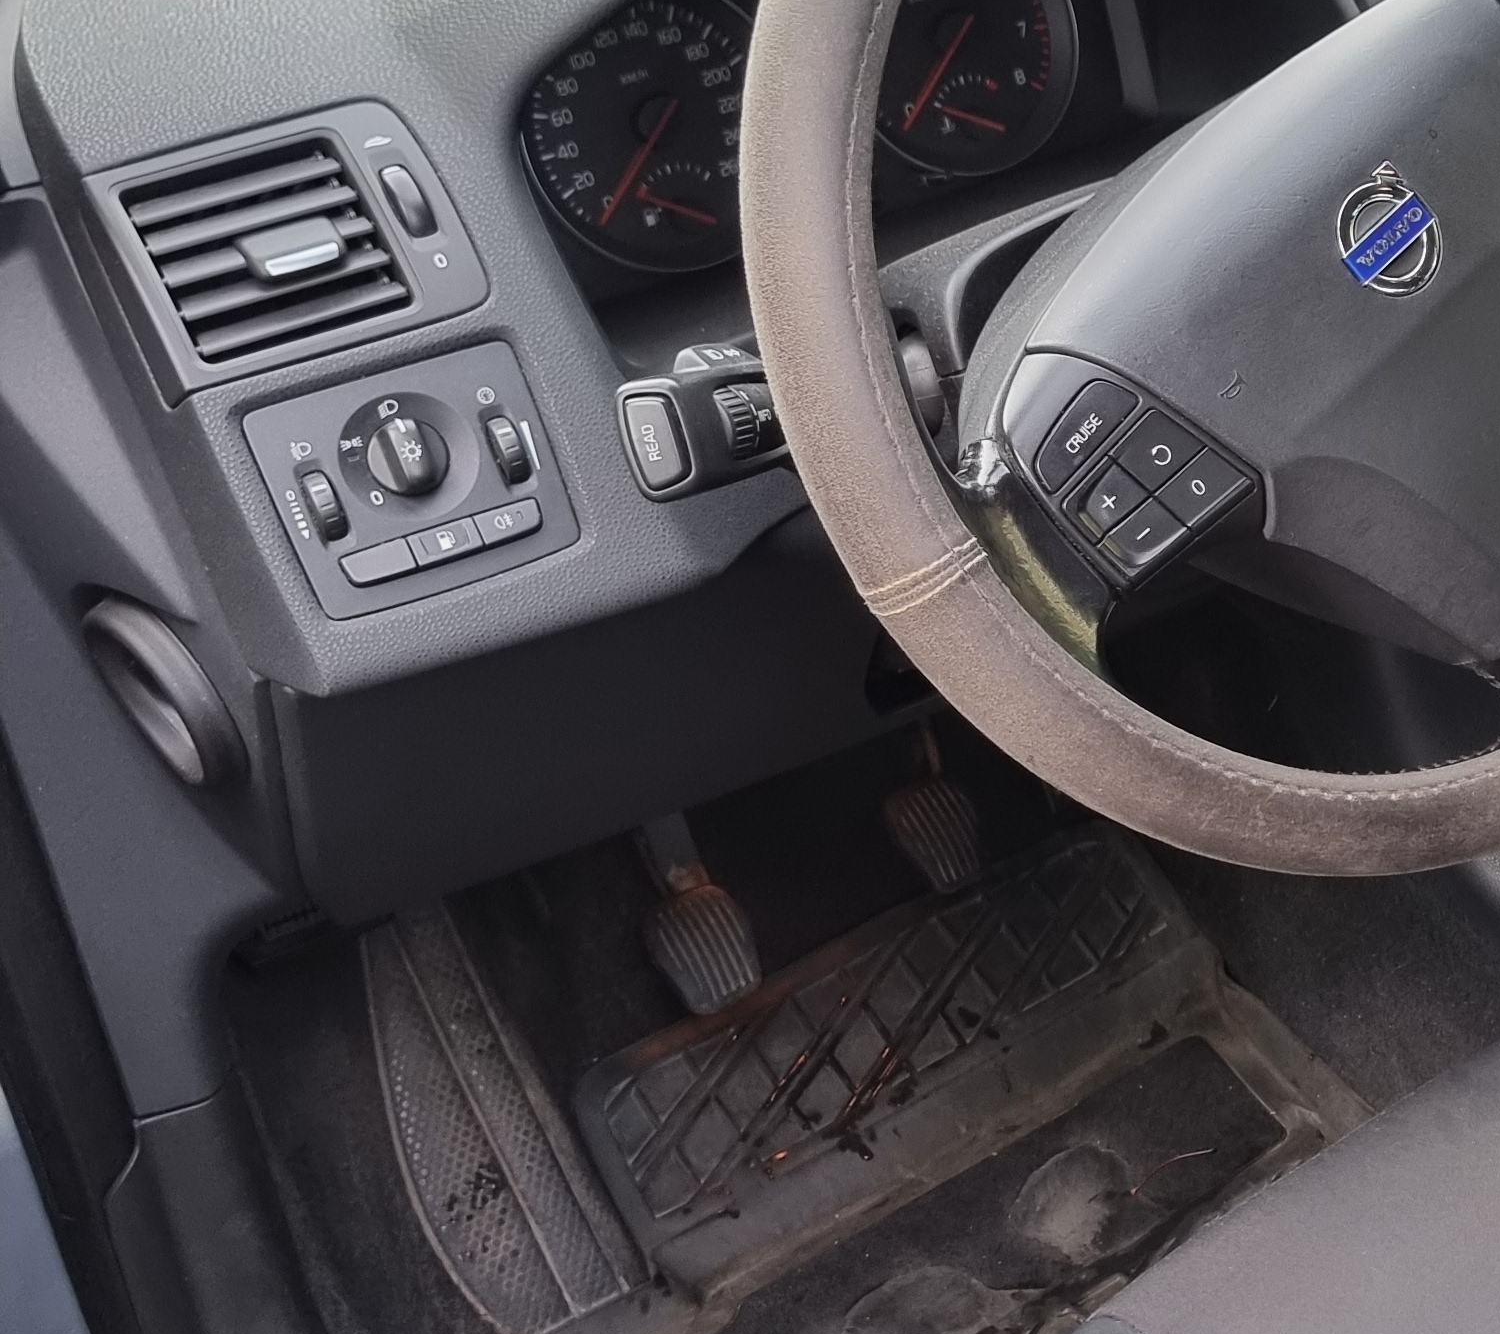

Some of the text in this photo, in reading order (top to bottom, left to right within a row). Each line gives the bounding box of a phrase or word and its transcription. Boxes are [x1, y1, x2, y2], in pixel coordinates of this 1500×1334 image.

[1015, 20, 1027, 38] 7
[569, 50, 596, 70] 100
[555, 77, 579, 96] 80
[701, 66, 731, 87] 200
[1013, 68, 1026, 85] 8
[718, 94, 740, 114] 22
[551, 108, 574, 127] 60
[557, 140, 579, 159] 40
[572, 169, 595, 191] 20
[1356, 207, 1423, 267] VOLVO
[641, 424, 663, 462] READ
[1065, 412, 1103, 454] CRUISE
